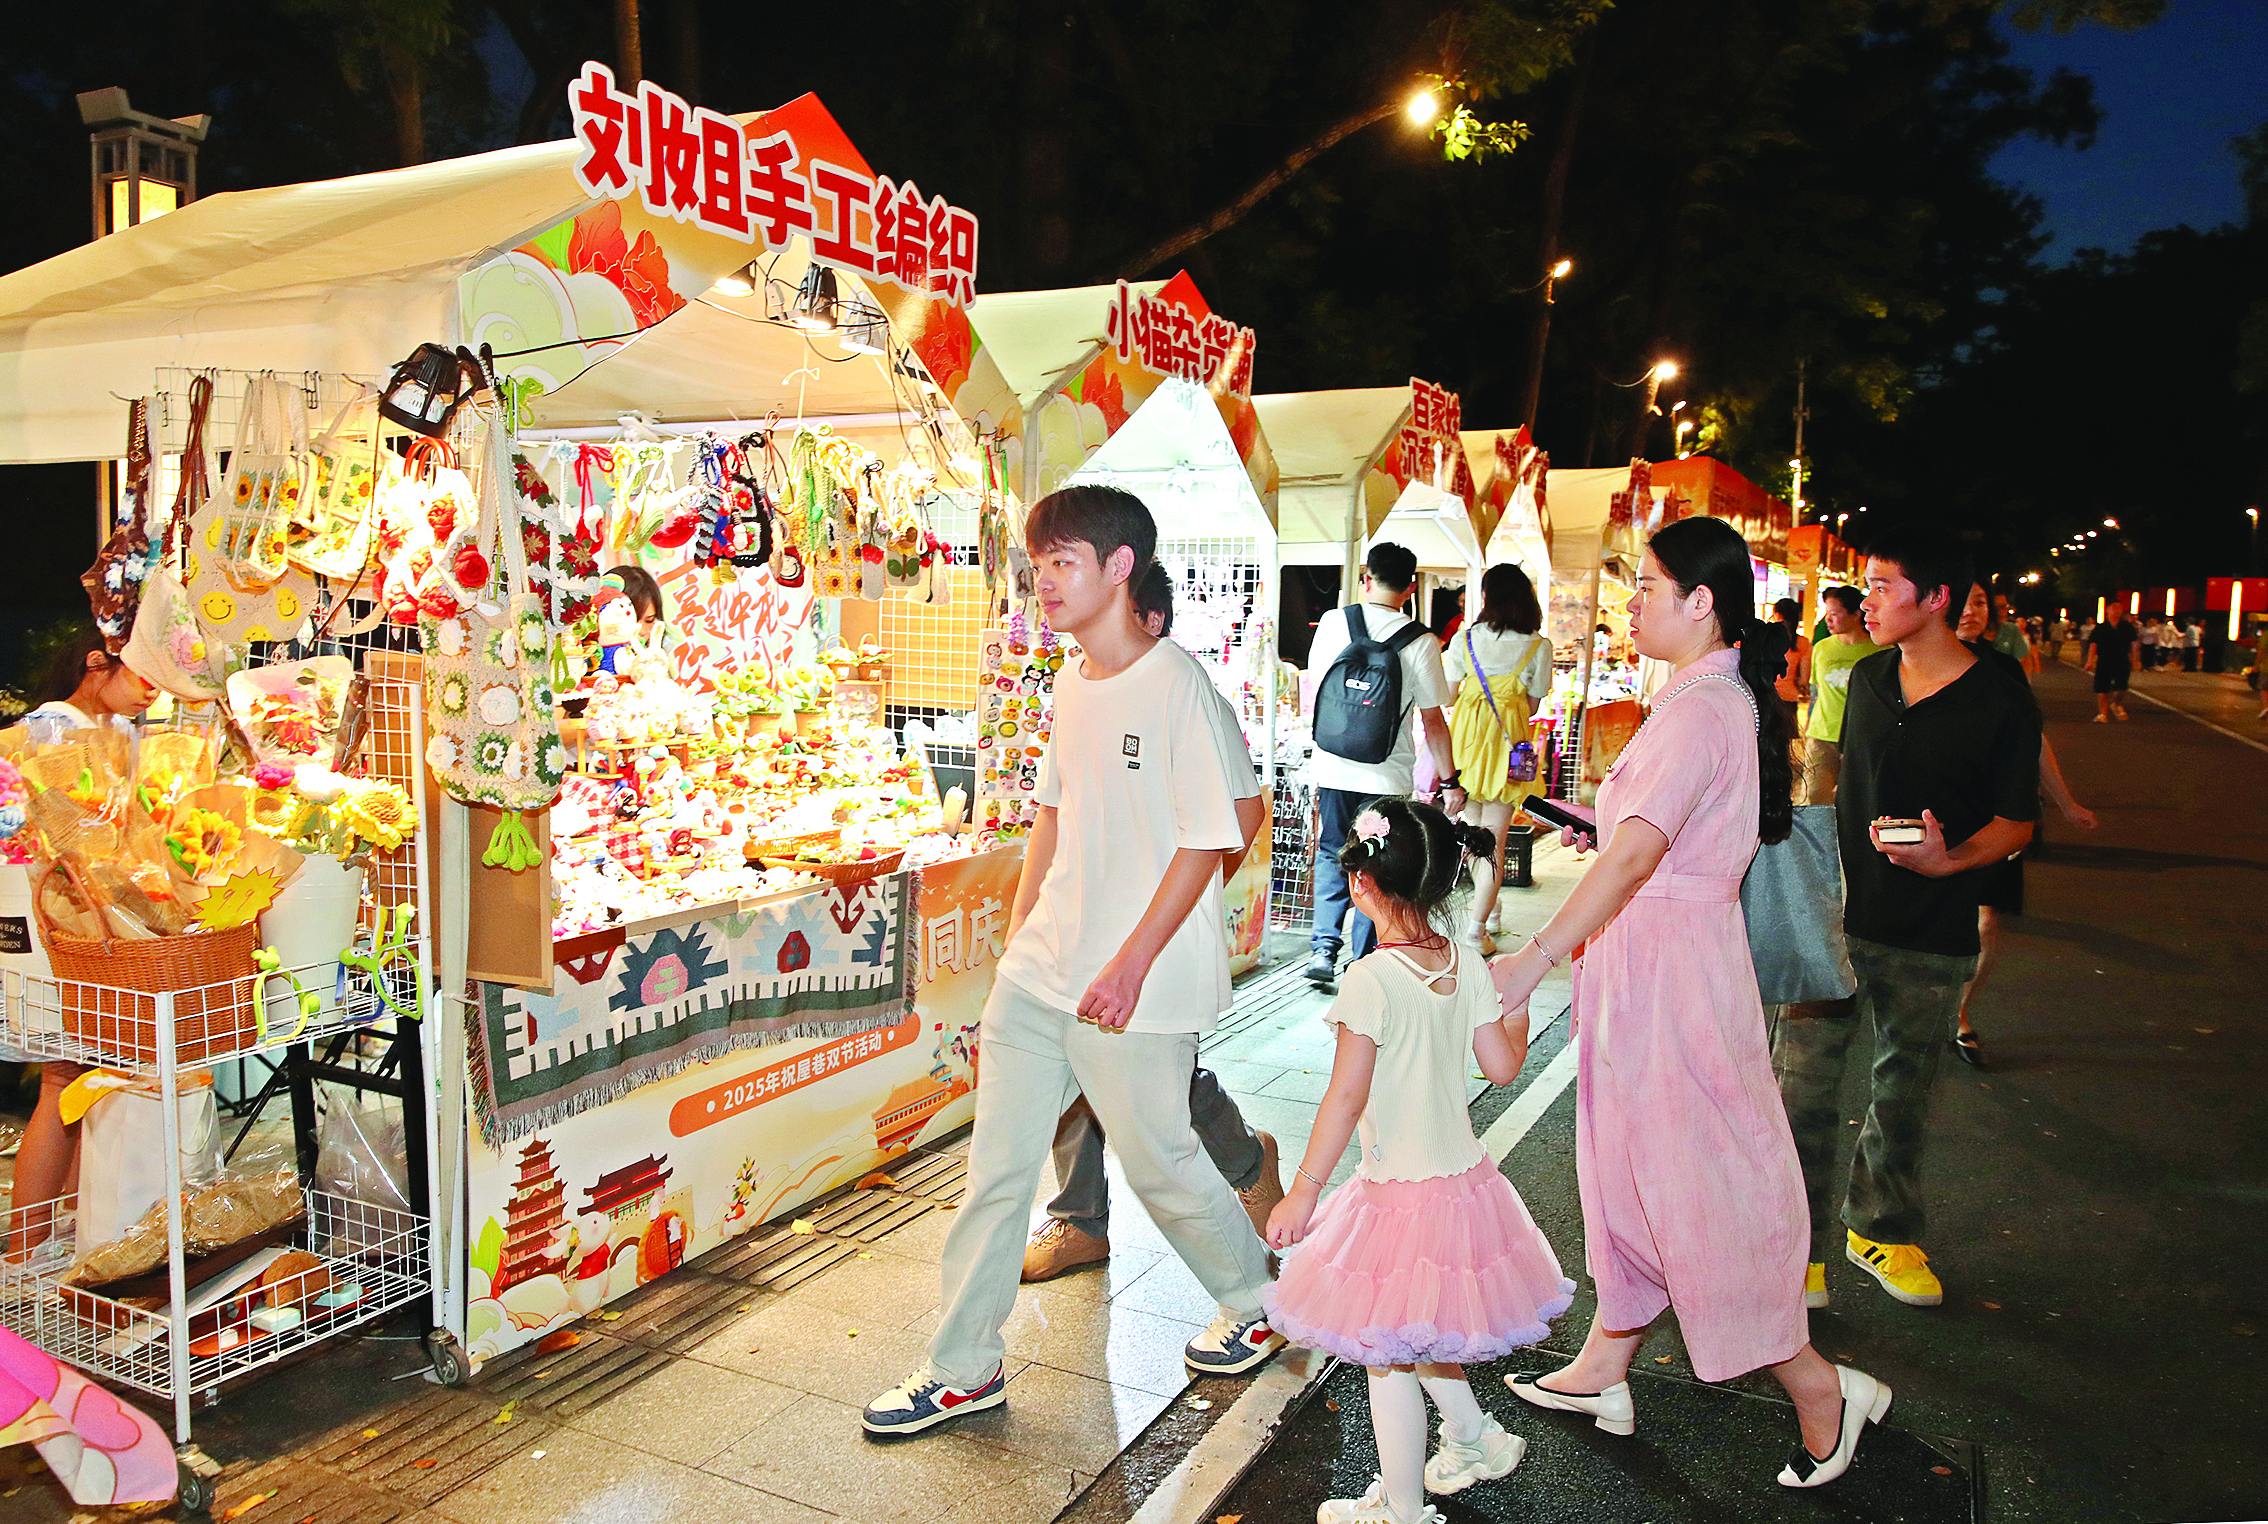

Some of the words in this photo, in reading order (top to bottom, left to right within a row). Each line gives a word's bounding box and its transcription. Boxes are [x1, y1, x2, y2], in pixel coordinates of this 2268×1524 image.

[578, 71, 975, 307] 刘姐手工编织
[917, 896, 1006, 983] 同庆
[723, 1031, 882, 1111] 2025年祝屋巷双节活动
